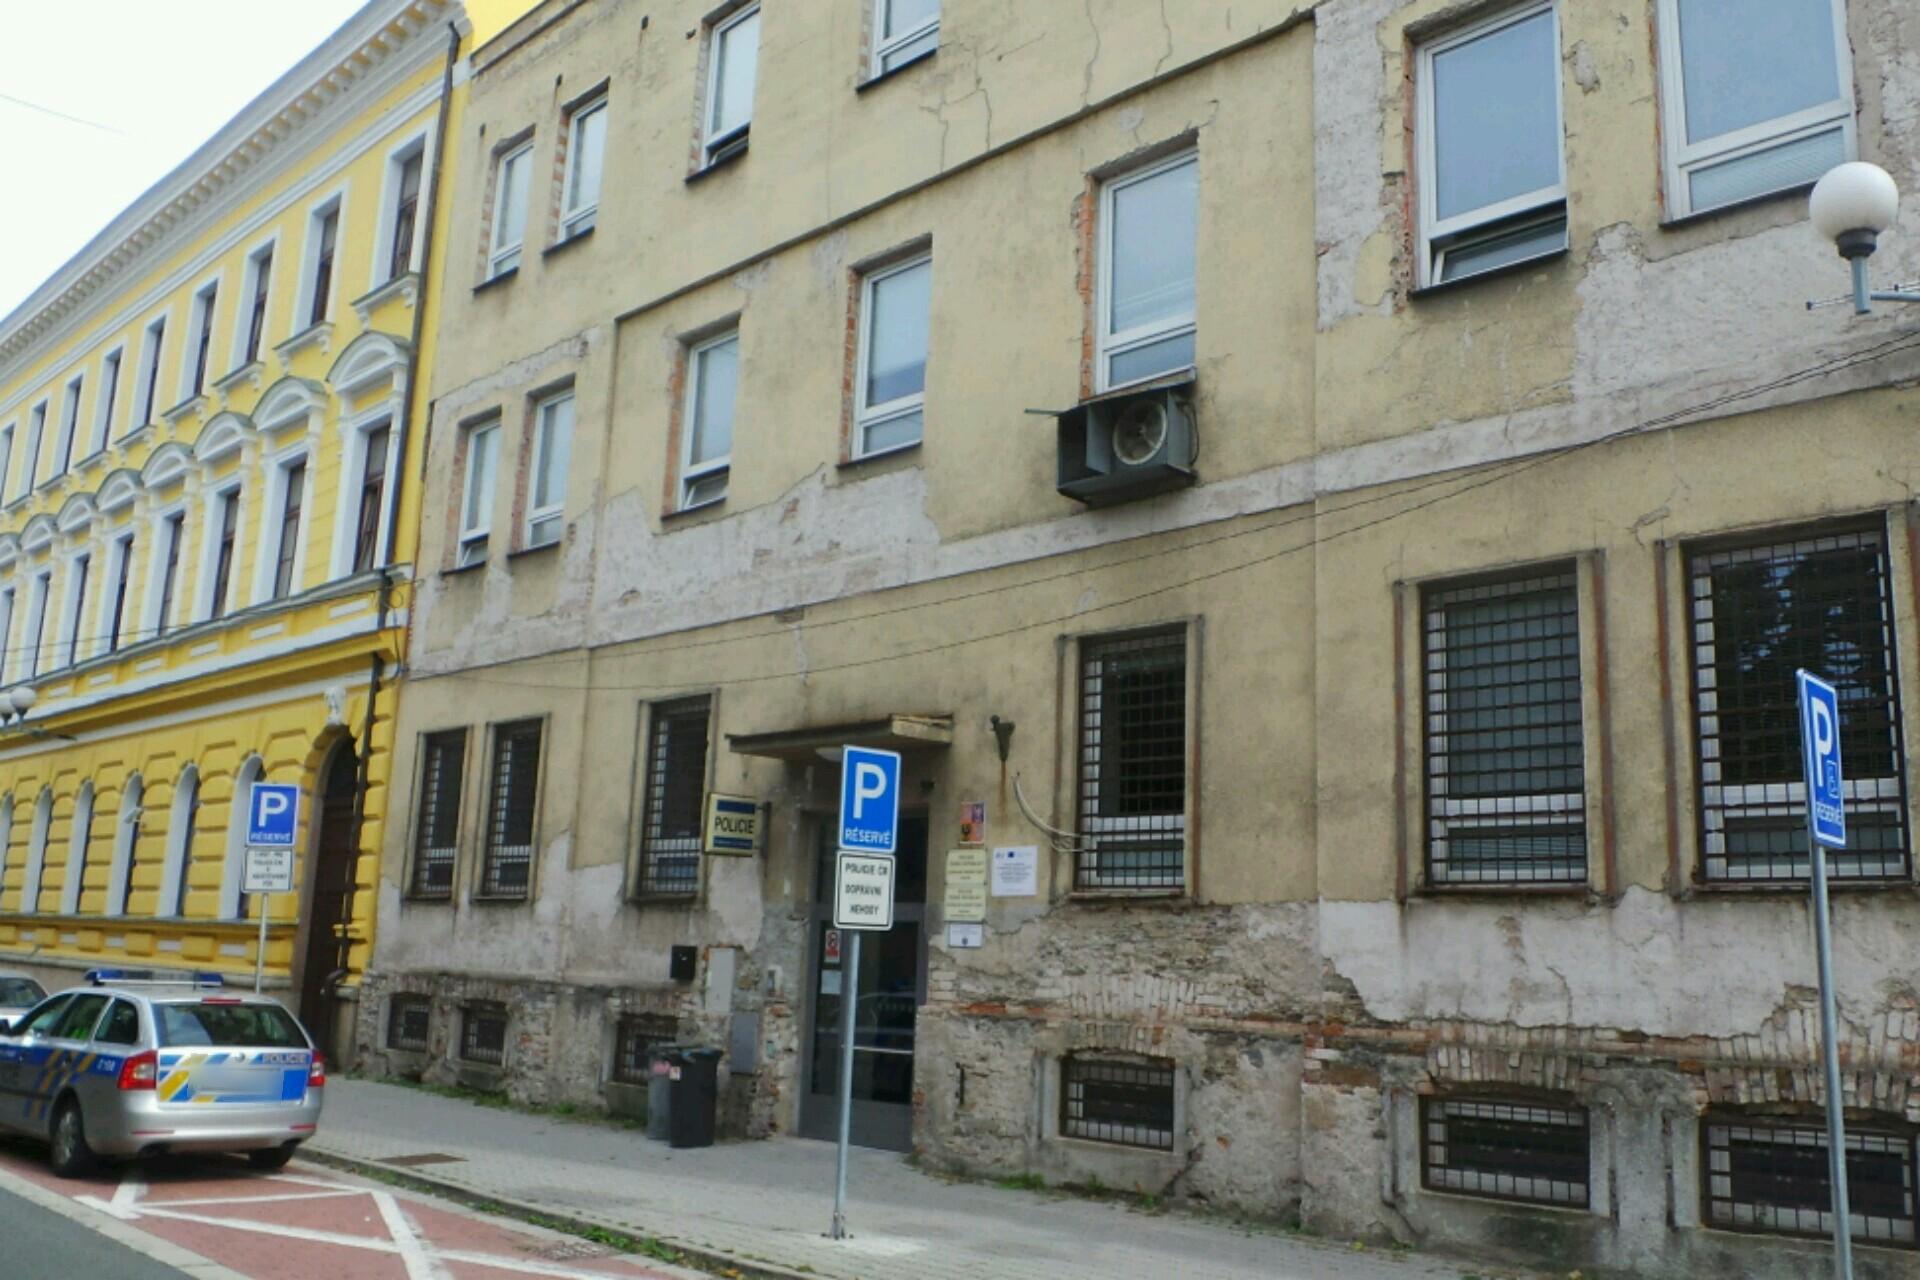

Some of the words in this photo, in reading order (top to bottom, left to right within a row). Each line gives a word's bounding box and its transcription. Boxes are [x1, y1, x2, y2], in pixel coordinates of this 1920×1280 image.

[1811, 696, 1833, 787] P
[853, 762, 887, 819] P
[258, 791, 289, 827] P
[715, 815, 754, 834] POLICIE
[845, 827, 892, 845] RÉSERVÉ
